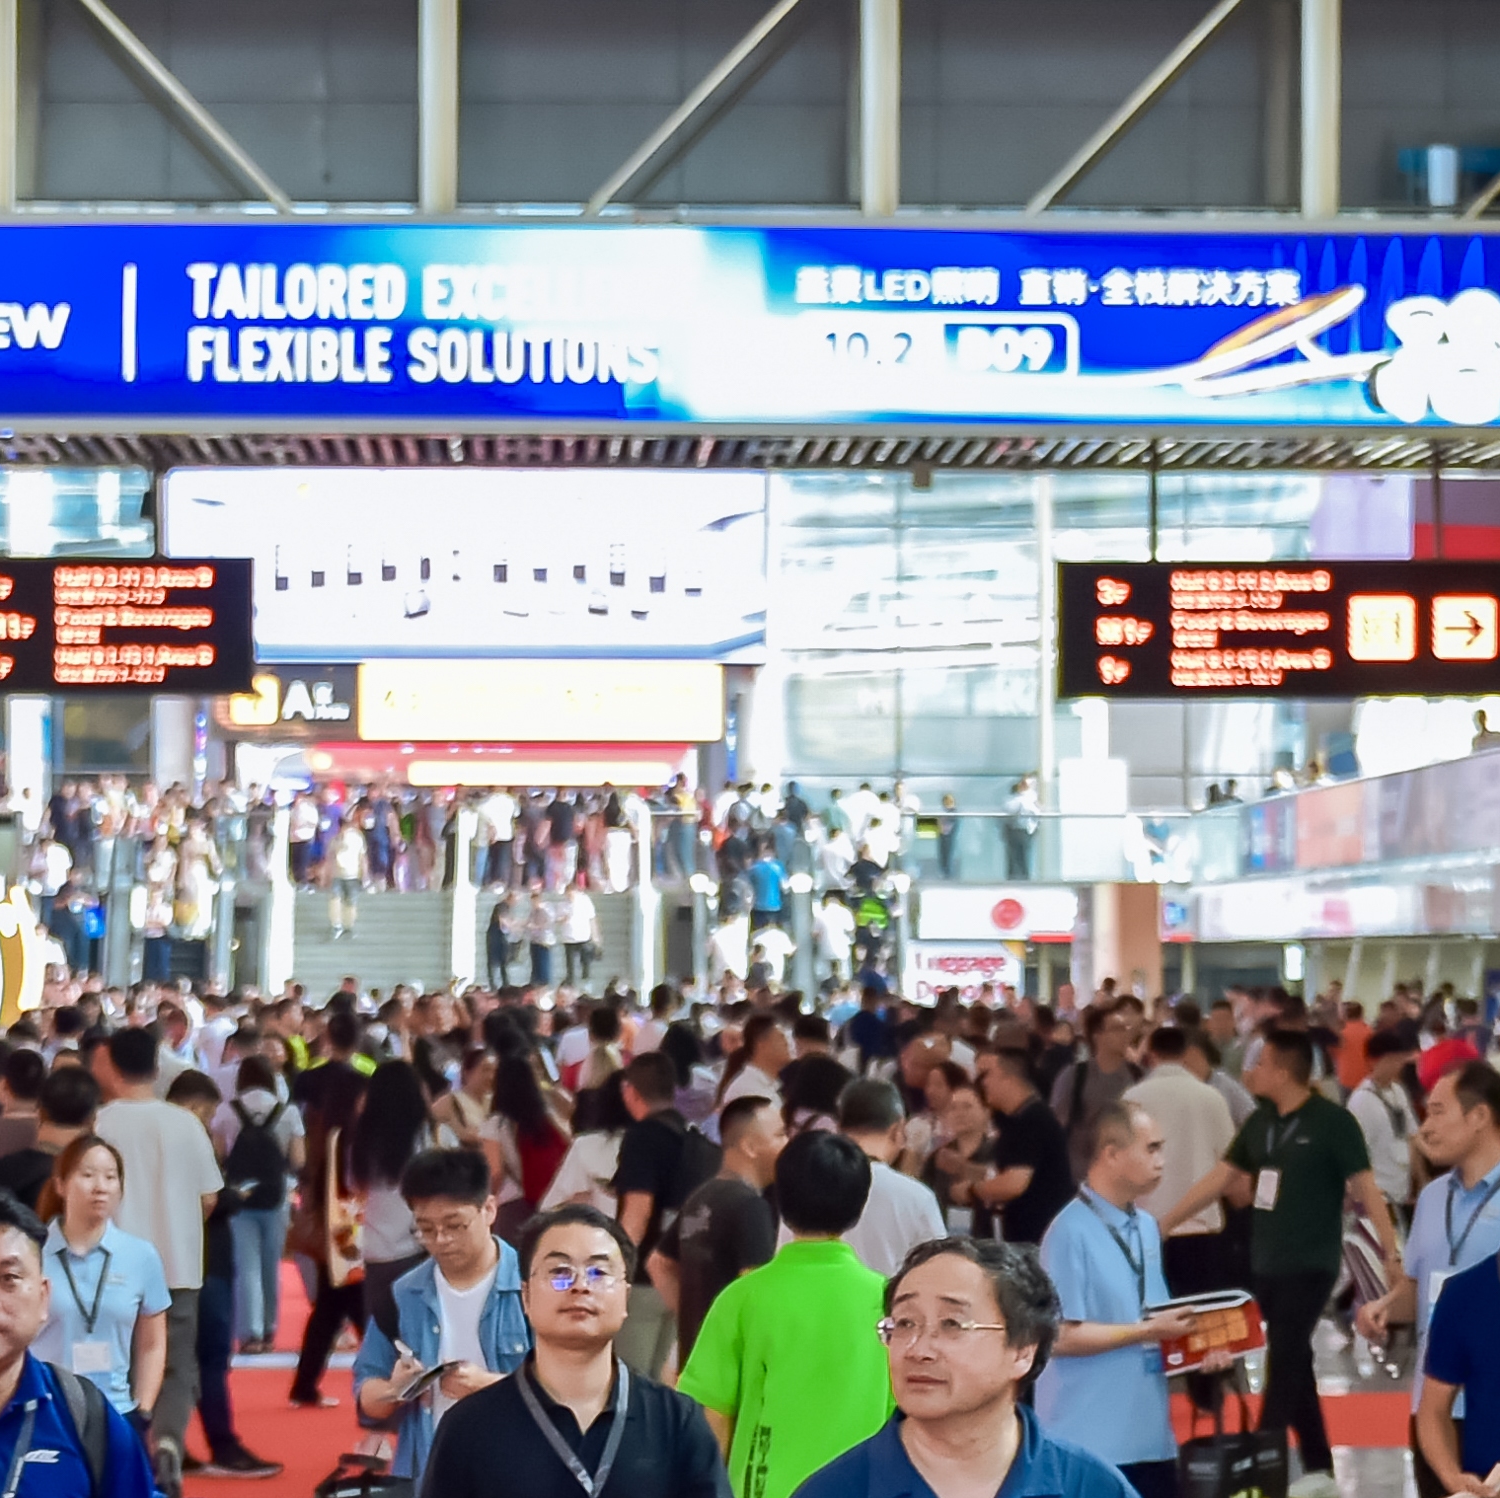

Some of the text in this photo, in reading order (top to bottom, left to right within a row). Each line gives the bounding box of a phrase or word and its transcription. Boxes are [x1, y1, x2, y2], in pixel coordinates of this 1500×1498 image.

[186, 262, 407, 321] TAILORED
[187, 327, 660, 384] FLEXIBLE SOLUTIONS
